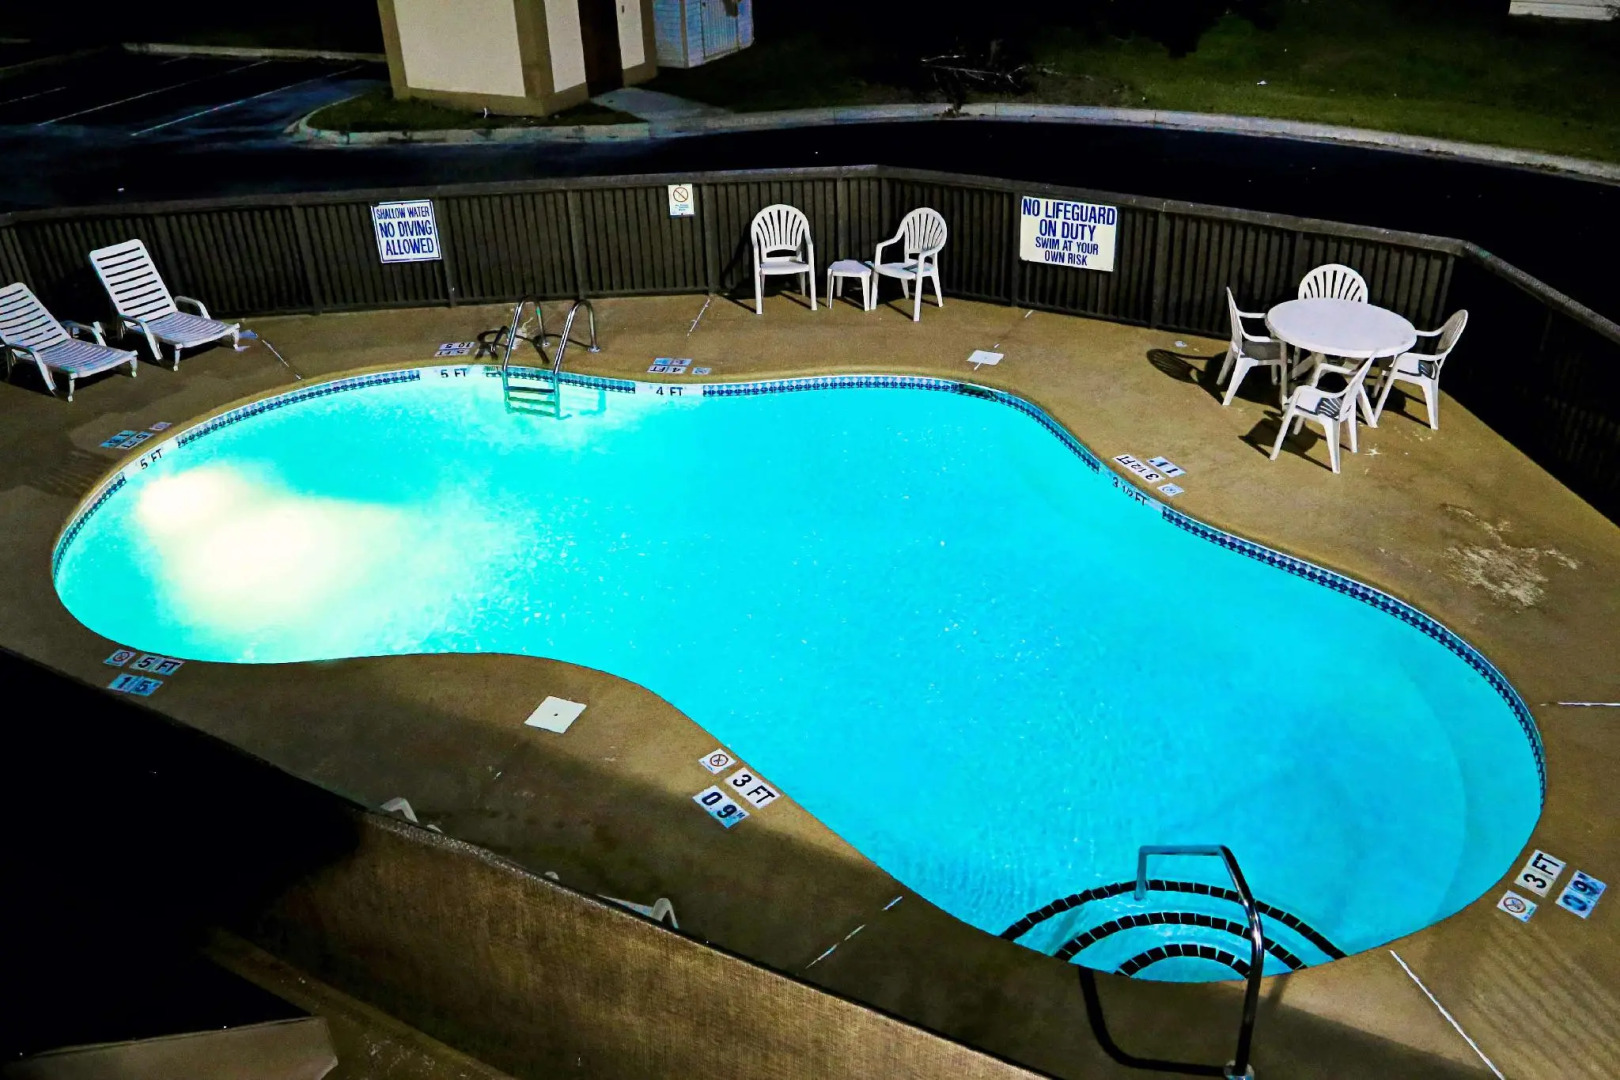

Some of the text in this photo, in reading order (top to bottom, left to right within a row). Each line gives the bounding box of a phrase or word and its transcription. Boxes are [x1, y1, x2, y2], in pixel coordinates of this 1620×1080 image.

[376, 206, 430, 220] SHALLOW WATER
[1023, 198, 1116, 226] NO LIFEGUARD
[379, 220, 433, 238] NO DIVING
[1039, 219, 1096, 241] ON DUTY
[385, 237, 434, 256] ALLOWED
[1035, 236, 1099, 256] SWIM AT YOUR
[1044, 249, 1088, 267] OWN RISK
[440, 367, 468, 378] 5 FT
[656, 386, 684, 397] 4 FT
[139, 448, 163, 470] 5 FT
[1116, 455, 1136, 466] FT
[1145, 472, 1160, 481] 3
[1112, 476, 1119, 488] 3
[1134, 491, 1148, 507] FT
[137, 657, 181, 674] 5 FT
[732, 773, 776, 804] 3 FT
[1531, 853, 1560, 876] FT
[1523, 873, 1547, 889] 3
